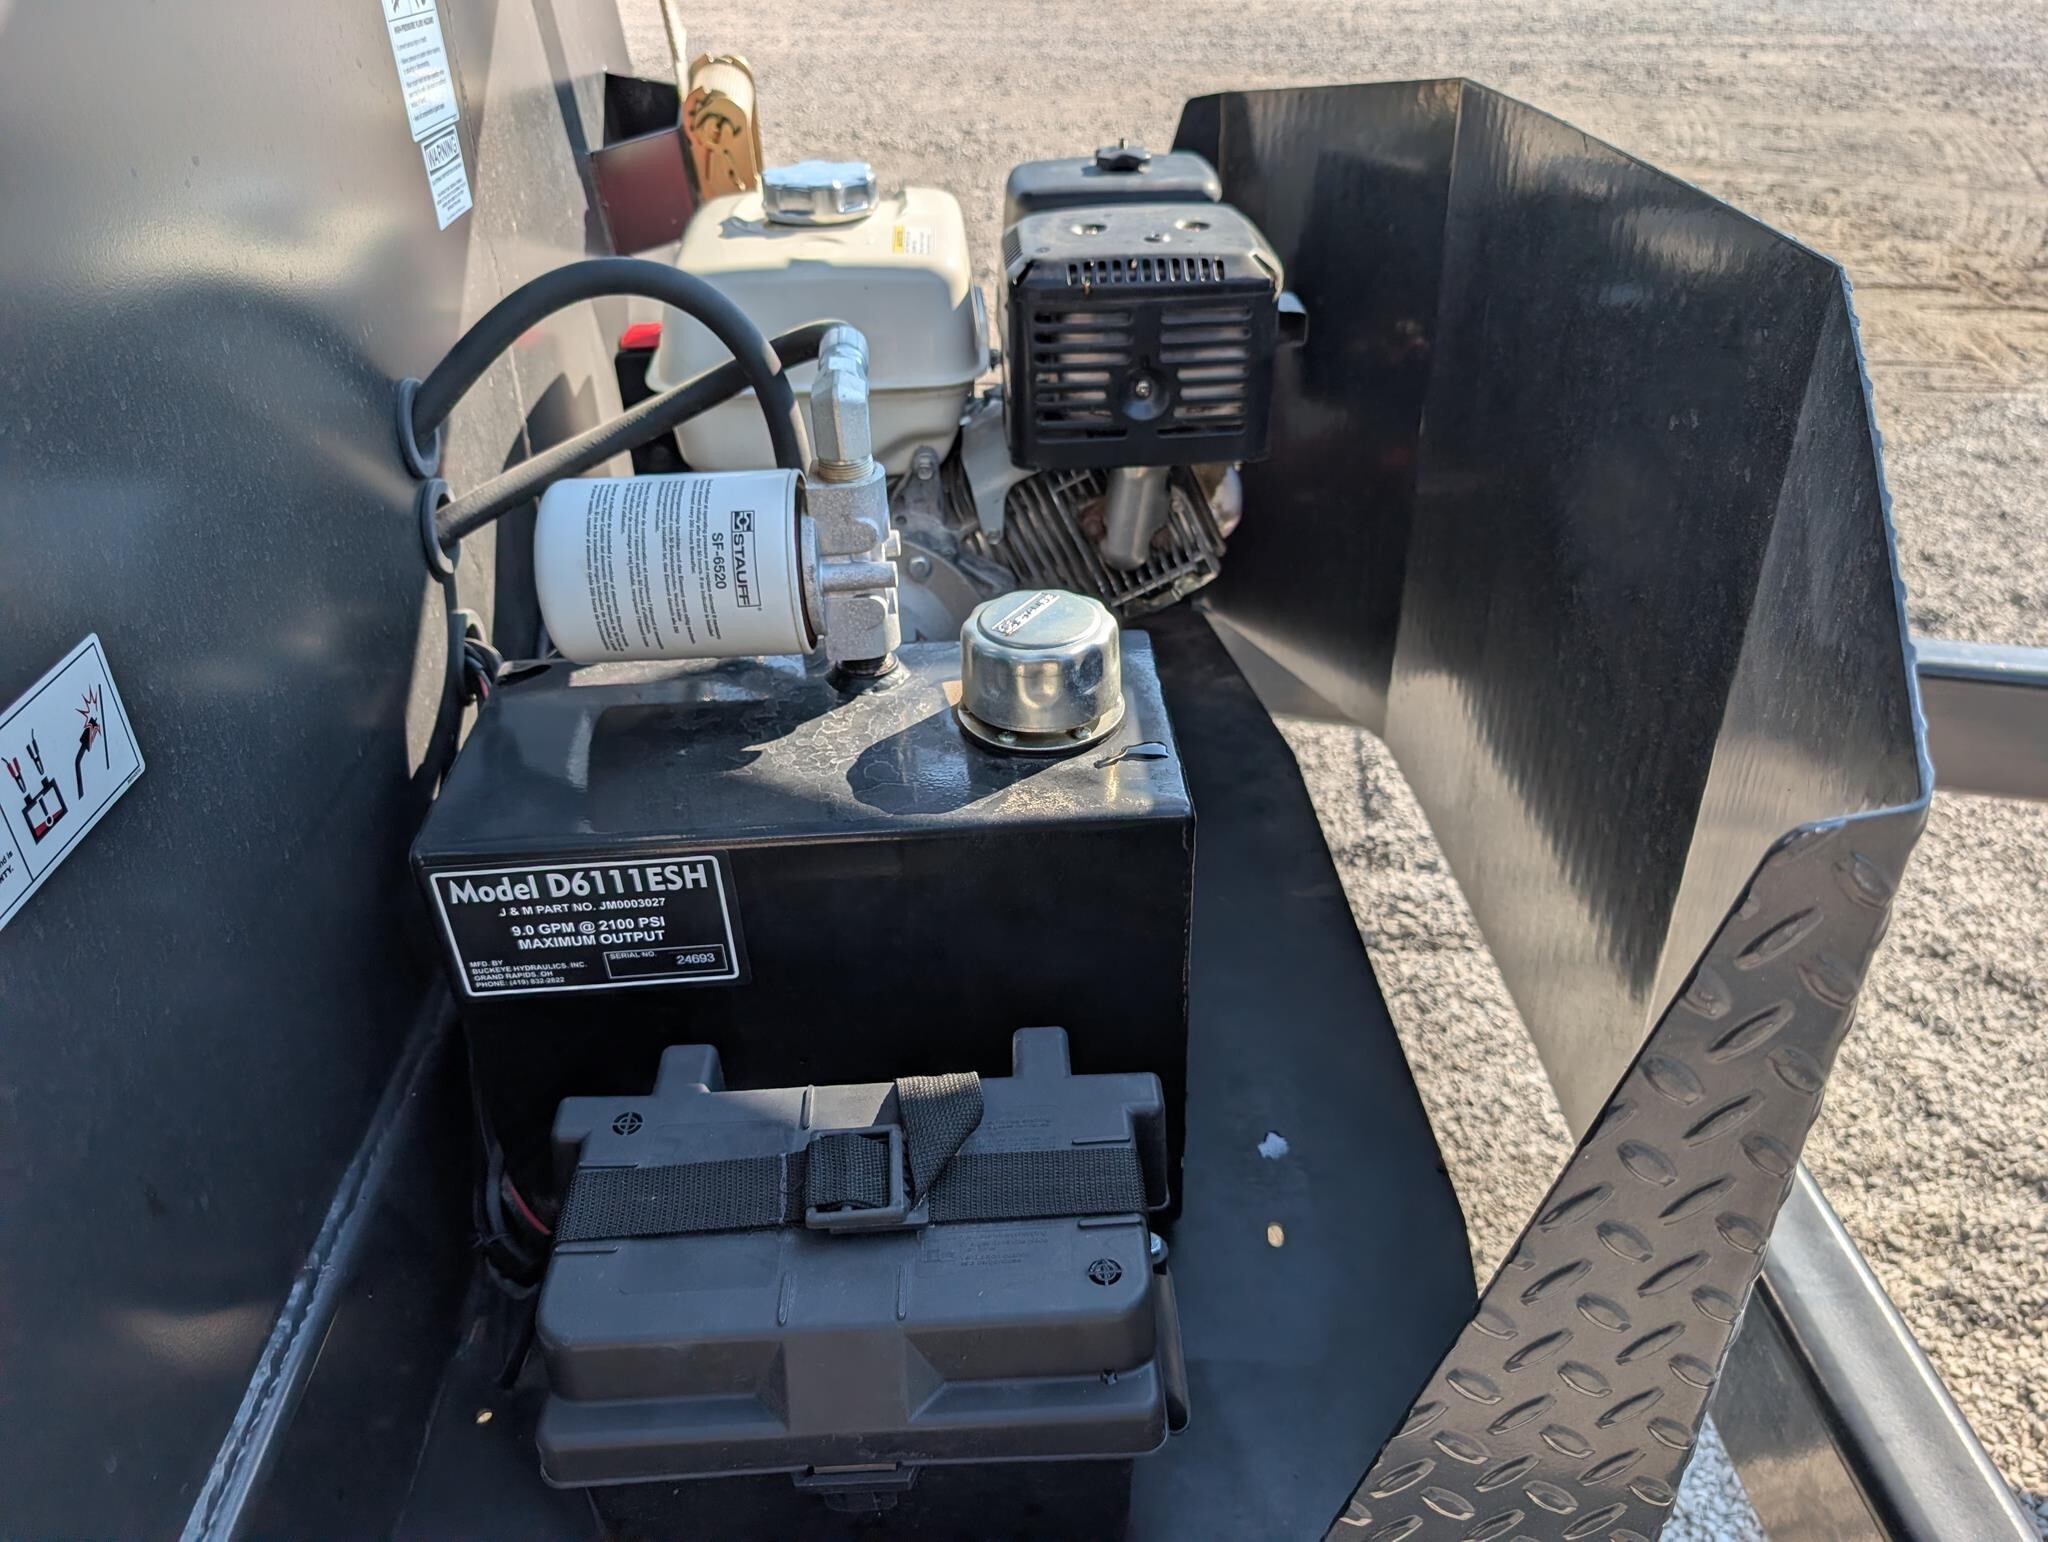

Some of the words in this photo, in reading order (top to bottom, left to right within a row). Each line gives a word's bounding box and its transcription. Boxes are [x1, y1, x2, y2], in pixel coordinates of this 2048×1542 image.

[426, 136, 458, 168] WARNING
[711, 532, 728, 590] SF-6520
[733, 534, 751, 607] STAUFF
[449, 875, 540, 904] Model
[547, 864, 708, 898] D6111ESH
[498, 908, 507, 917] J
[510, 906, 520, 916] &
[522, 906, 533, 915] M
[536, 903, 569, 914] PART
[573, 902, 597, 913] NO.
[600, 897, 666, 911] JM0003027
[511, 925, 535, 937] 9.0
[538, 922, 575, 935] GPM
[579, 921, 597, 934] @
[599, 918, 635, 931] 2100
[637, 915, 666, 929] PSI
[518, 935, 597, 950] MAXIMUM
[600, 930, 665, 945] OUTPUT
[609, 951, 641, 960] SERIAL
[675, 952, 716, 965] 24693
[472, 965, 512, 975] BUCKEYE
[474, 973, 504, 982] GRAND
[540, 970, 553, 978] OH
